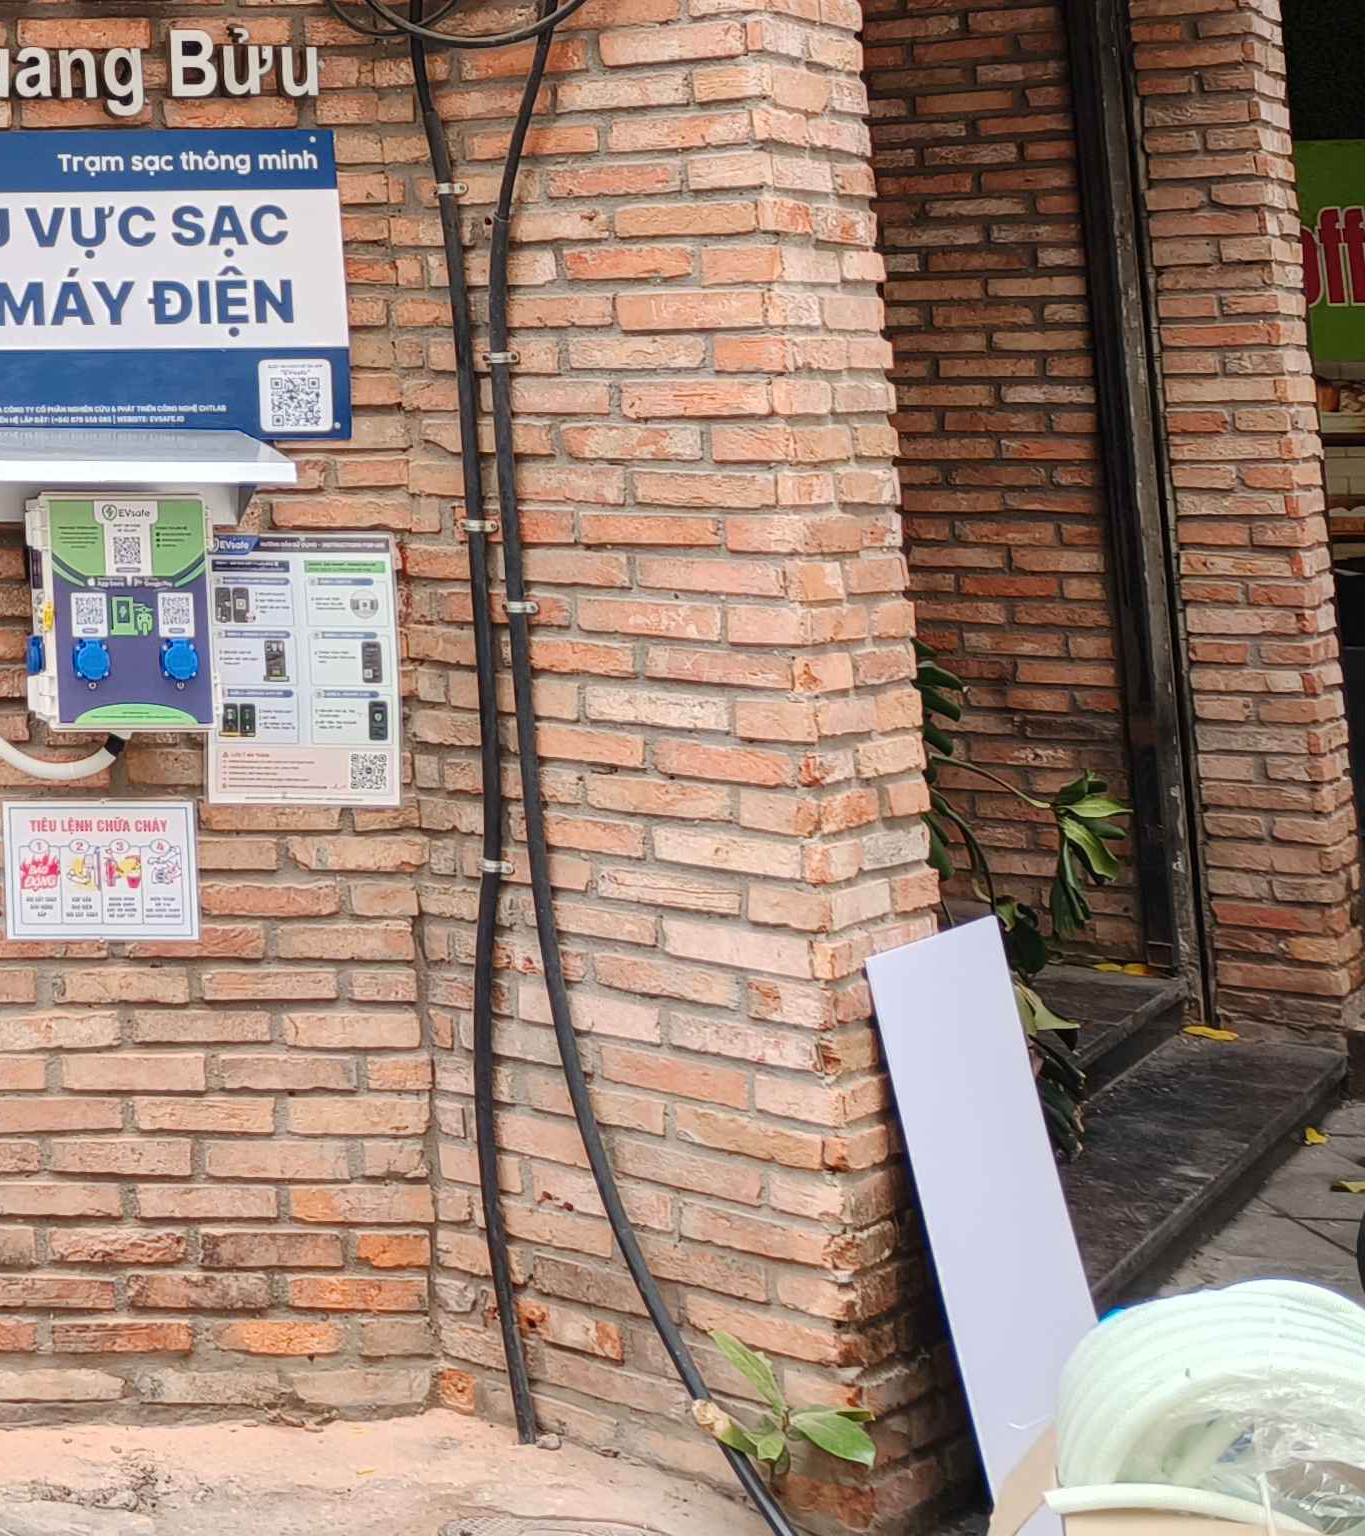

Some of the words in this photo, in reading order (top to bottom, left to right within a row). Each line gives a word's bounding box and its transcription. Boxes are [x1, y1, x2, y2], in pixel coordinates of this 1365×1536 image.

[168, 27, 320, 99] Bửu
[58, 153, 125, 176] Trạm
[131, 154, 174, 176] sạc
[180, 150, 252, 175] thông
[258, 149, 319, 170] minh
[24, 205, 157, 259] VỰC
[171, 204, 289, 258] SẠC
[147, 265, 295, 337] ĐIỆN
[29, 817, 57, 833] TIÊU
[61, 817, 93, 835] LỆNH
[96, 816, 131, 833] CHỮA
[134, 816, 168, 833] CHÁY
[75, 842, 84, 851] 2
[116, 841, 125, 851] 3
